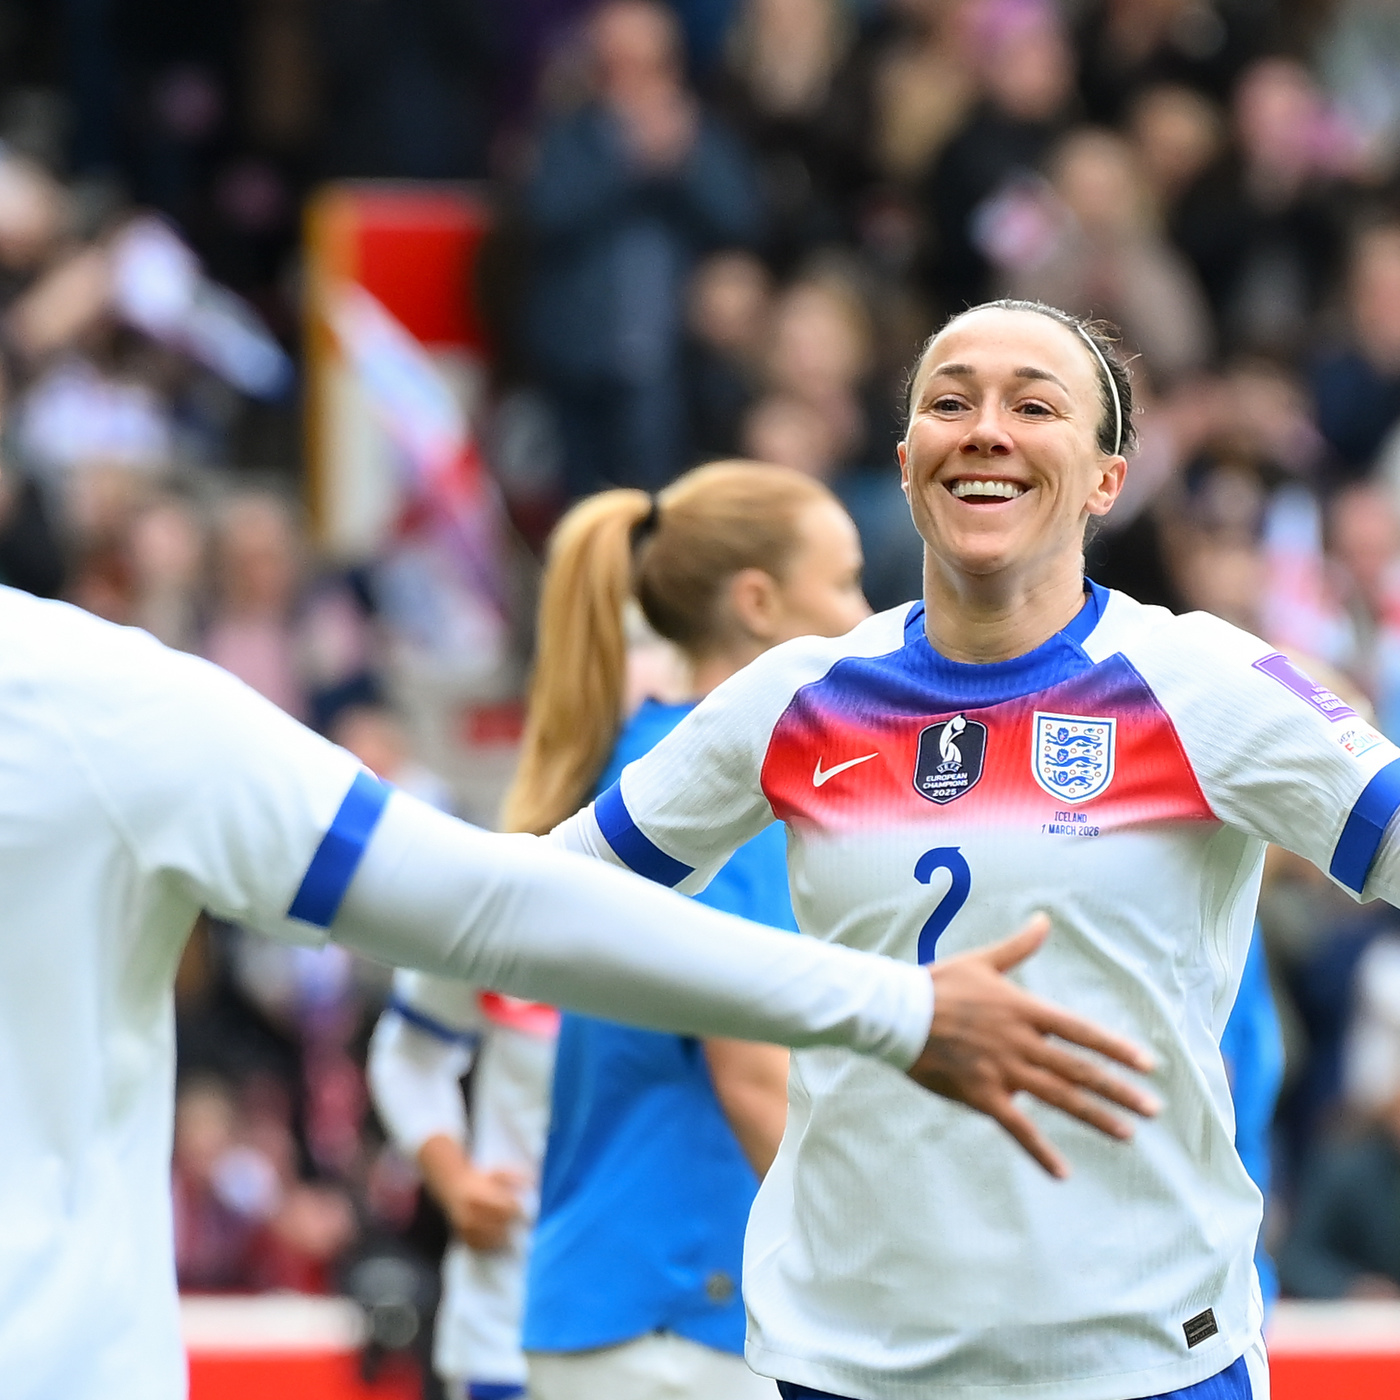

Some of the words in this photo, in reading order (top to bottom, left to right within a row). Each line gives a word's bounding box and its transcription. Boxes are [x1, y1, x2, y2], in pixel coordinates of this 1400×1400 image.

[925, 772, 968, 782] EUROPEAN
[922, 780, 969, 790] CHAMPIONS
[932, 788, 958, 797] 2025
[1054, 811, 1088, 824] ICELAND
[1041, 823, 1047, 834] 1
[1048, 823, 1077, 836] MARCH
[1078, 825, 1100, 837] 2026
[913, 846, 972, 966] 2
